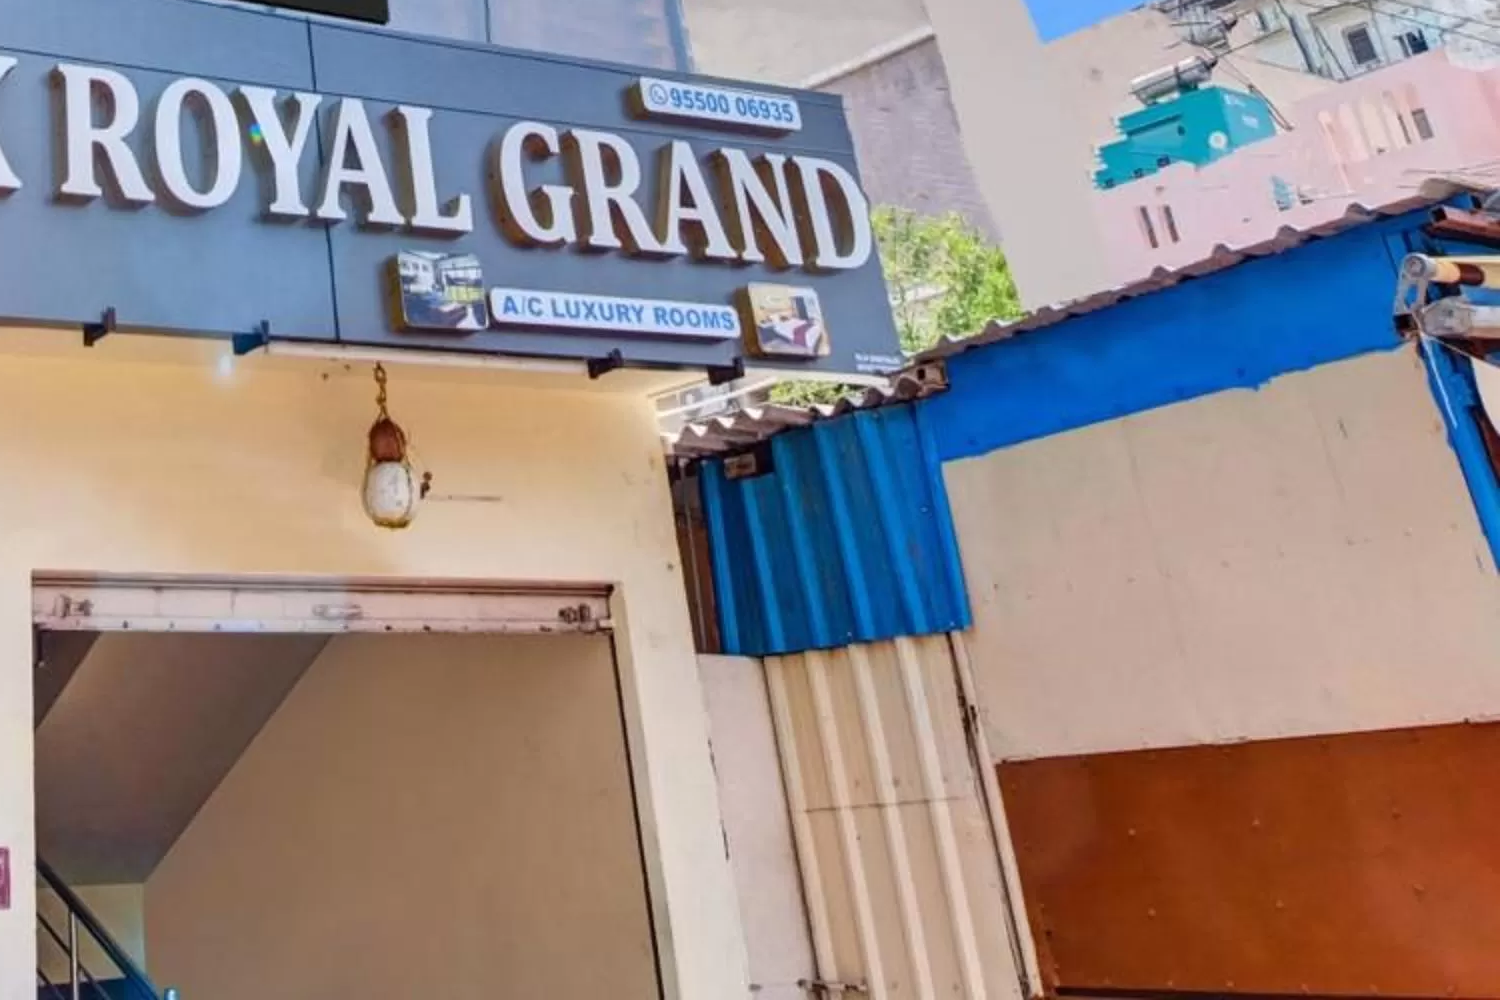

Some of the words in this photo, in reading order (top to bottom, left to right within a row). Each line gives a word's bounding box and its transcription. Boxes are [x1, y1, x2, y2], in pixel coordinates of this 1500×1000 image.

[669, 87, 730, 116] 95500
[735, 96, 794, 123] 06935
[55, 63, 472, 233] ROYAL
[499, 121, 873, 270] GRAND
[502, 293, 544, 317] A/C
[553, 297, 646, 323] LUXURY
[653, 306, 736, 331] ROOMS
